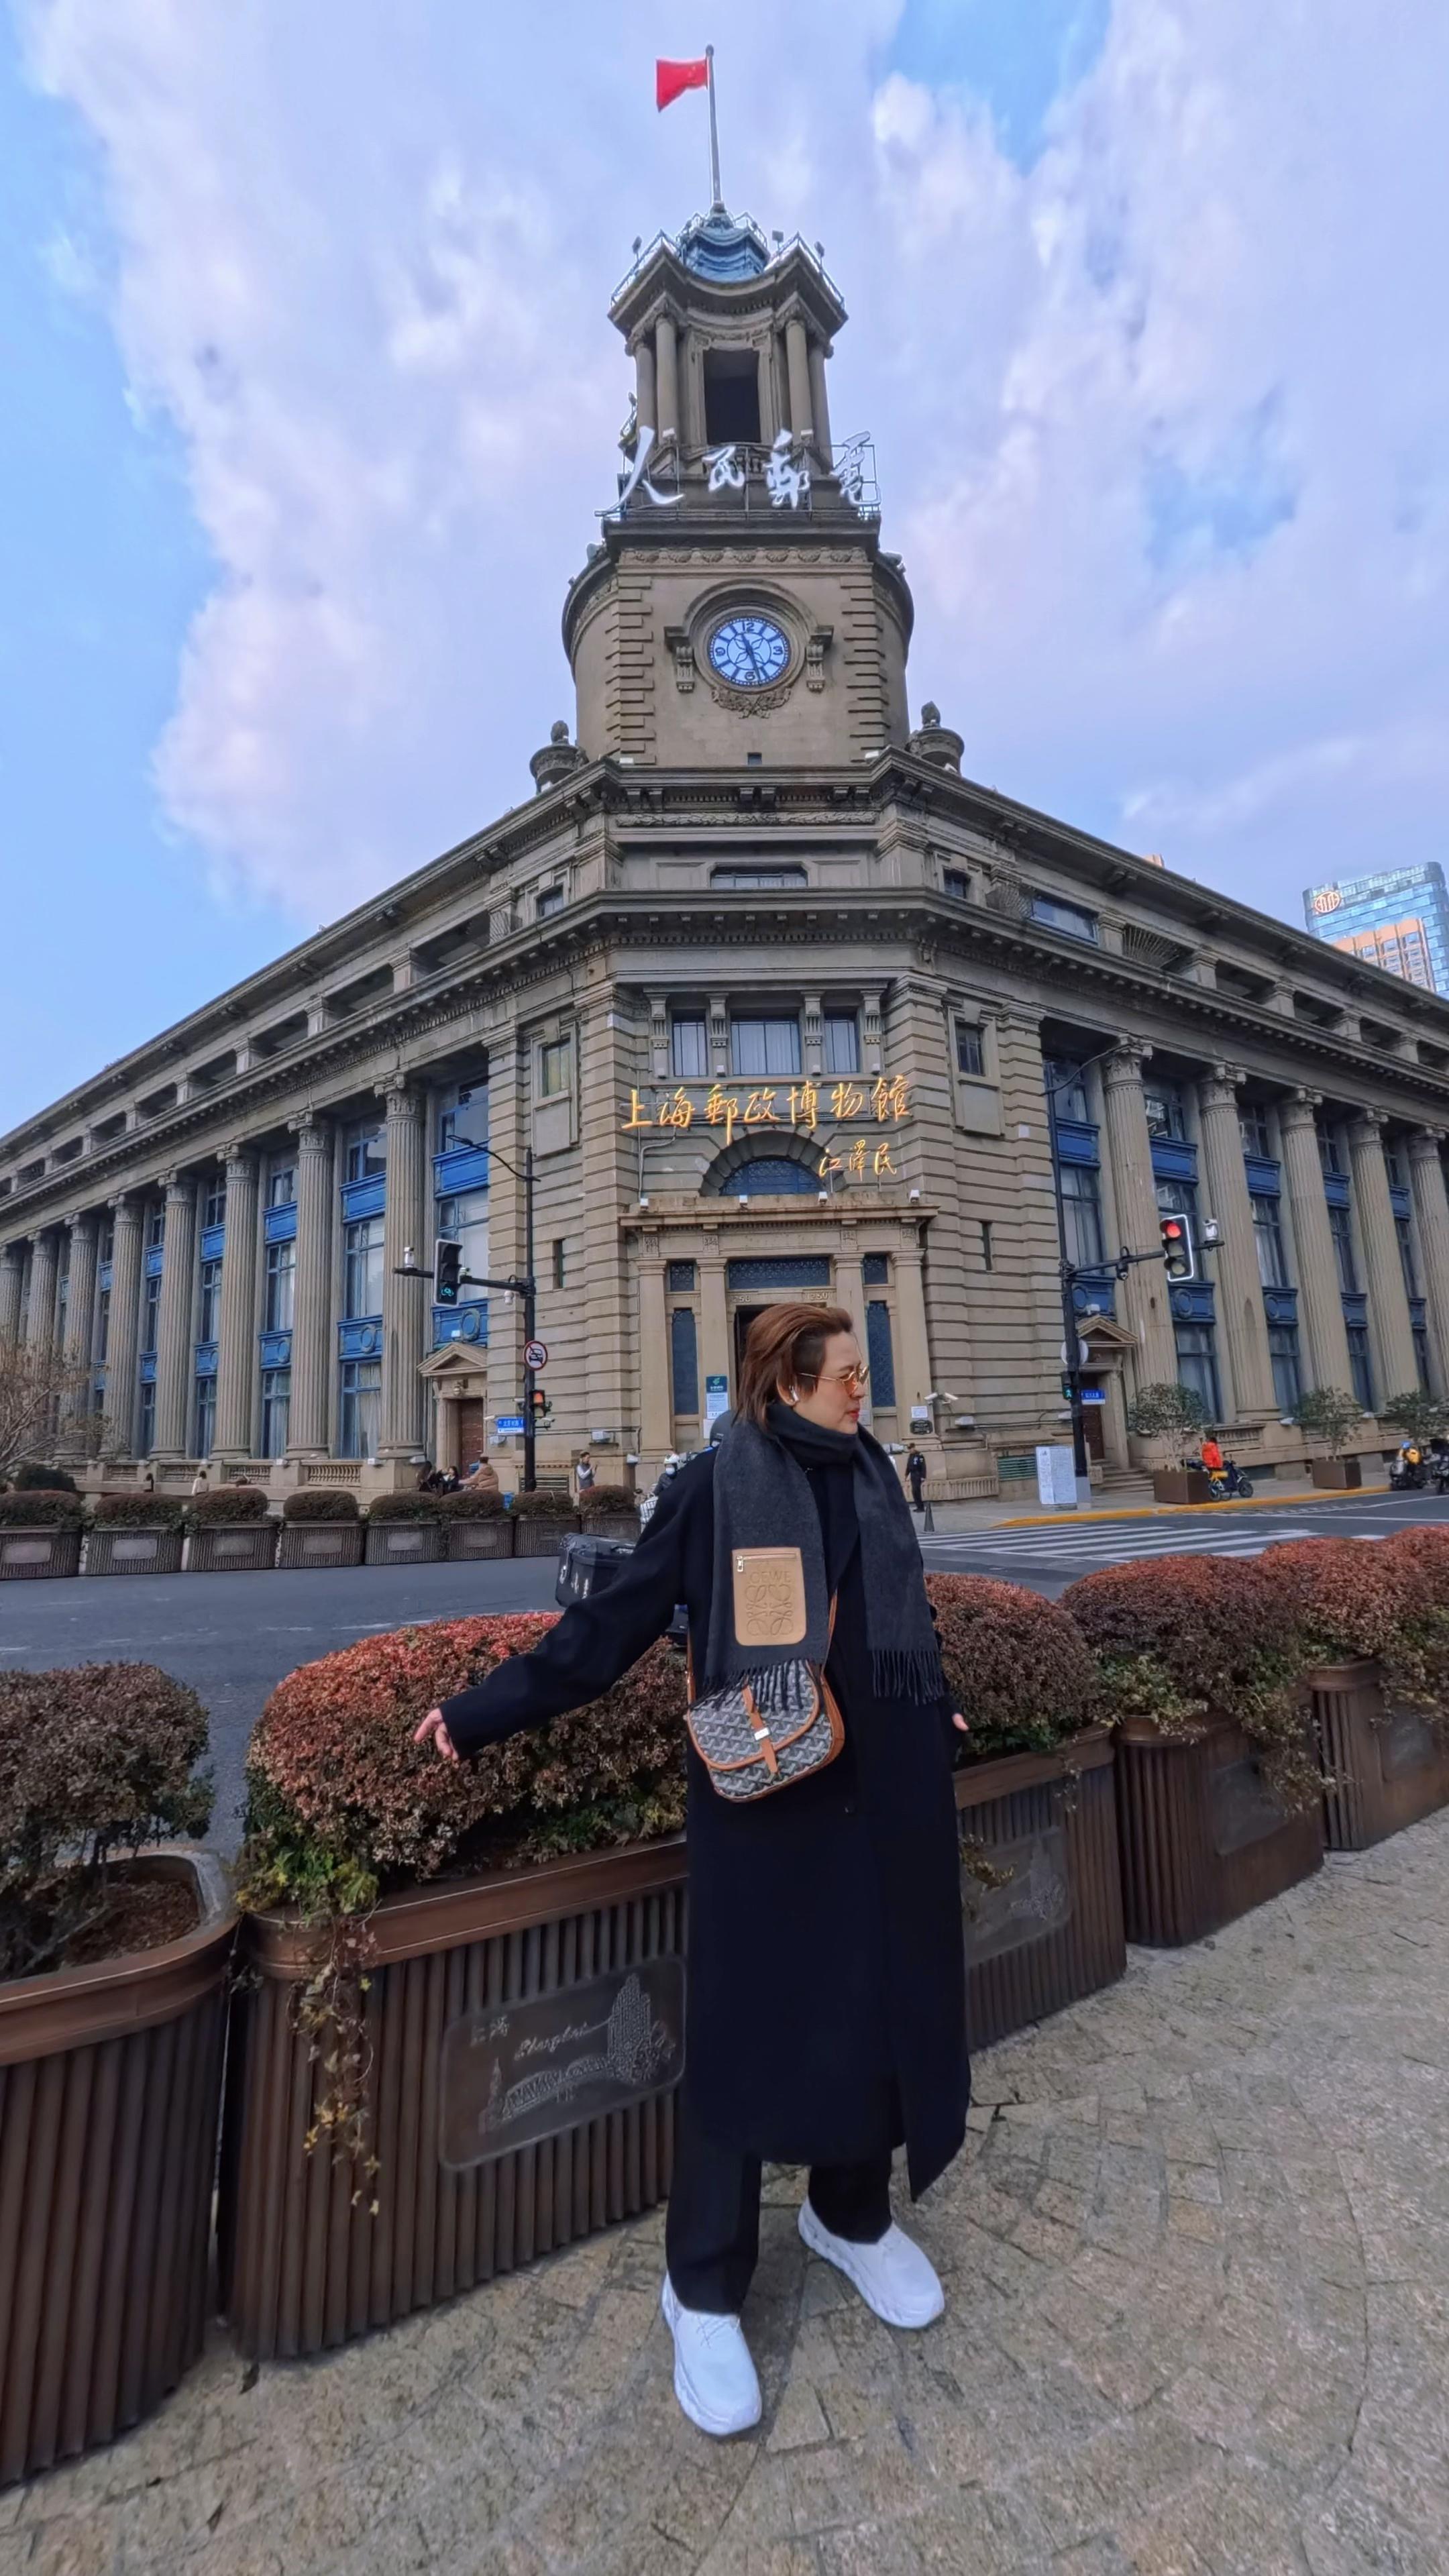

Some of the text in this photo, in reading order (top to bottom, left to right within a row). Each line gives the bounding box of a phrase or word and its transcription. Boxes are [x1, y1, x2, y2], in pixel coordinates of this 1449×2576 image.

[742, 621, 755, 632] 12
[715, 647, 726, 656] 9
[773, 645, 784, 655] 3
[745, 672, 755, 681] 6
[747, 1570, 792, 1585] OEWE
